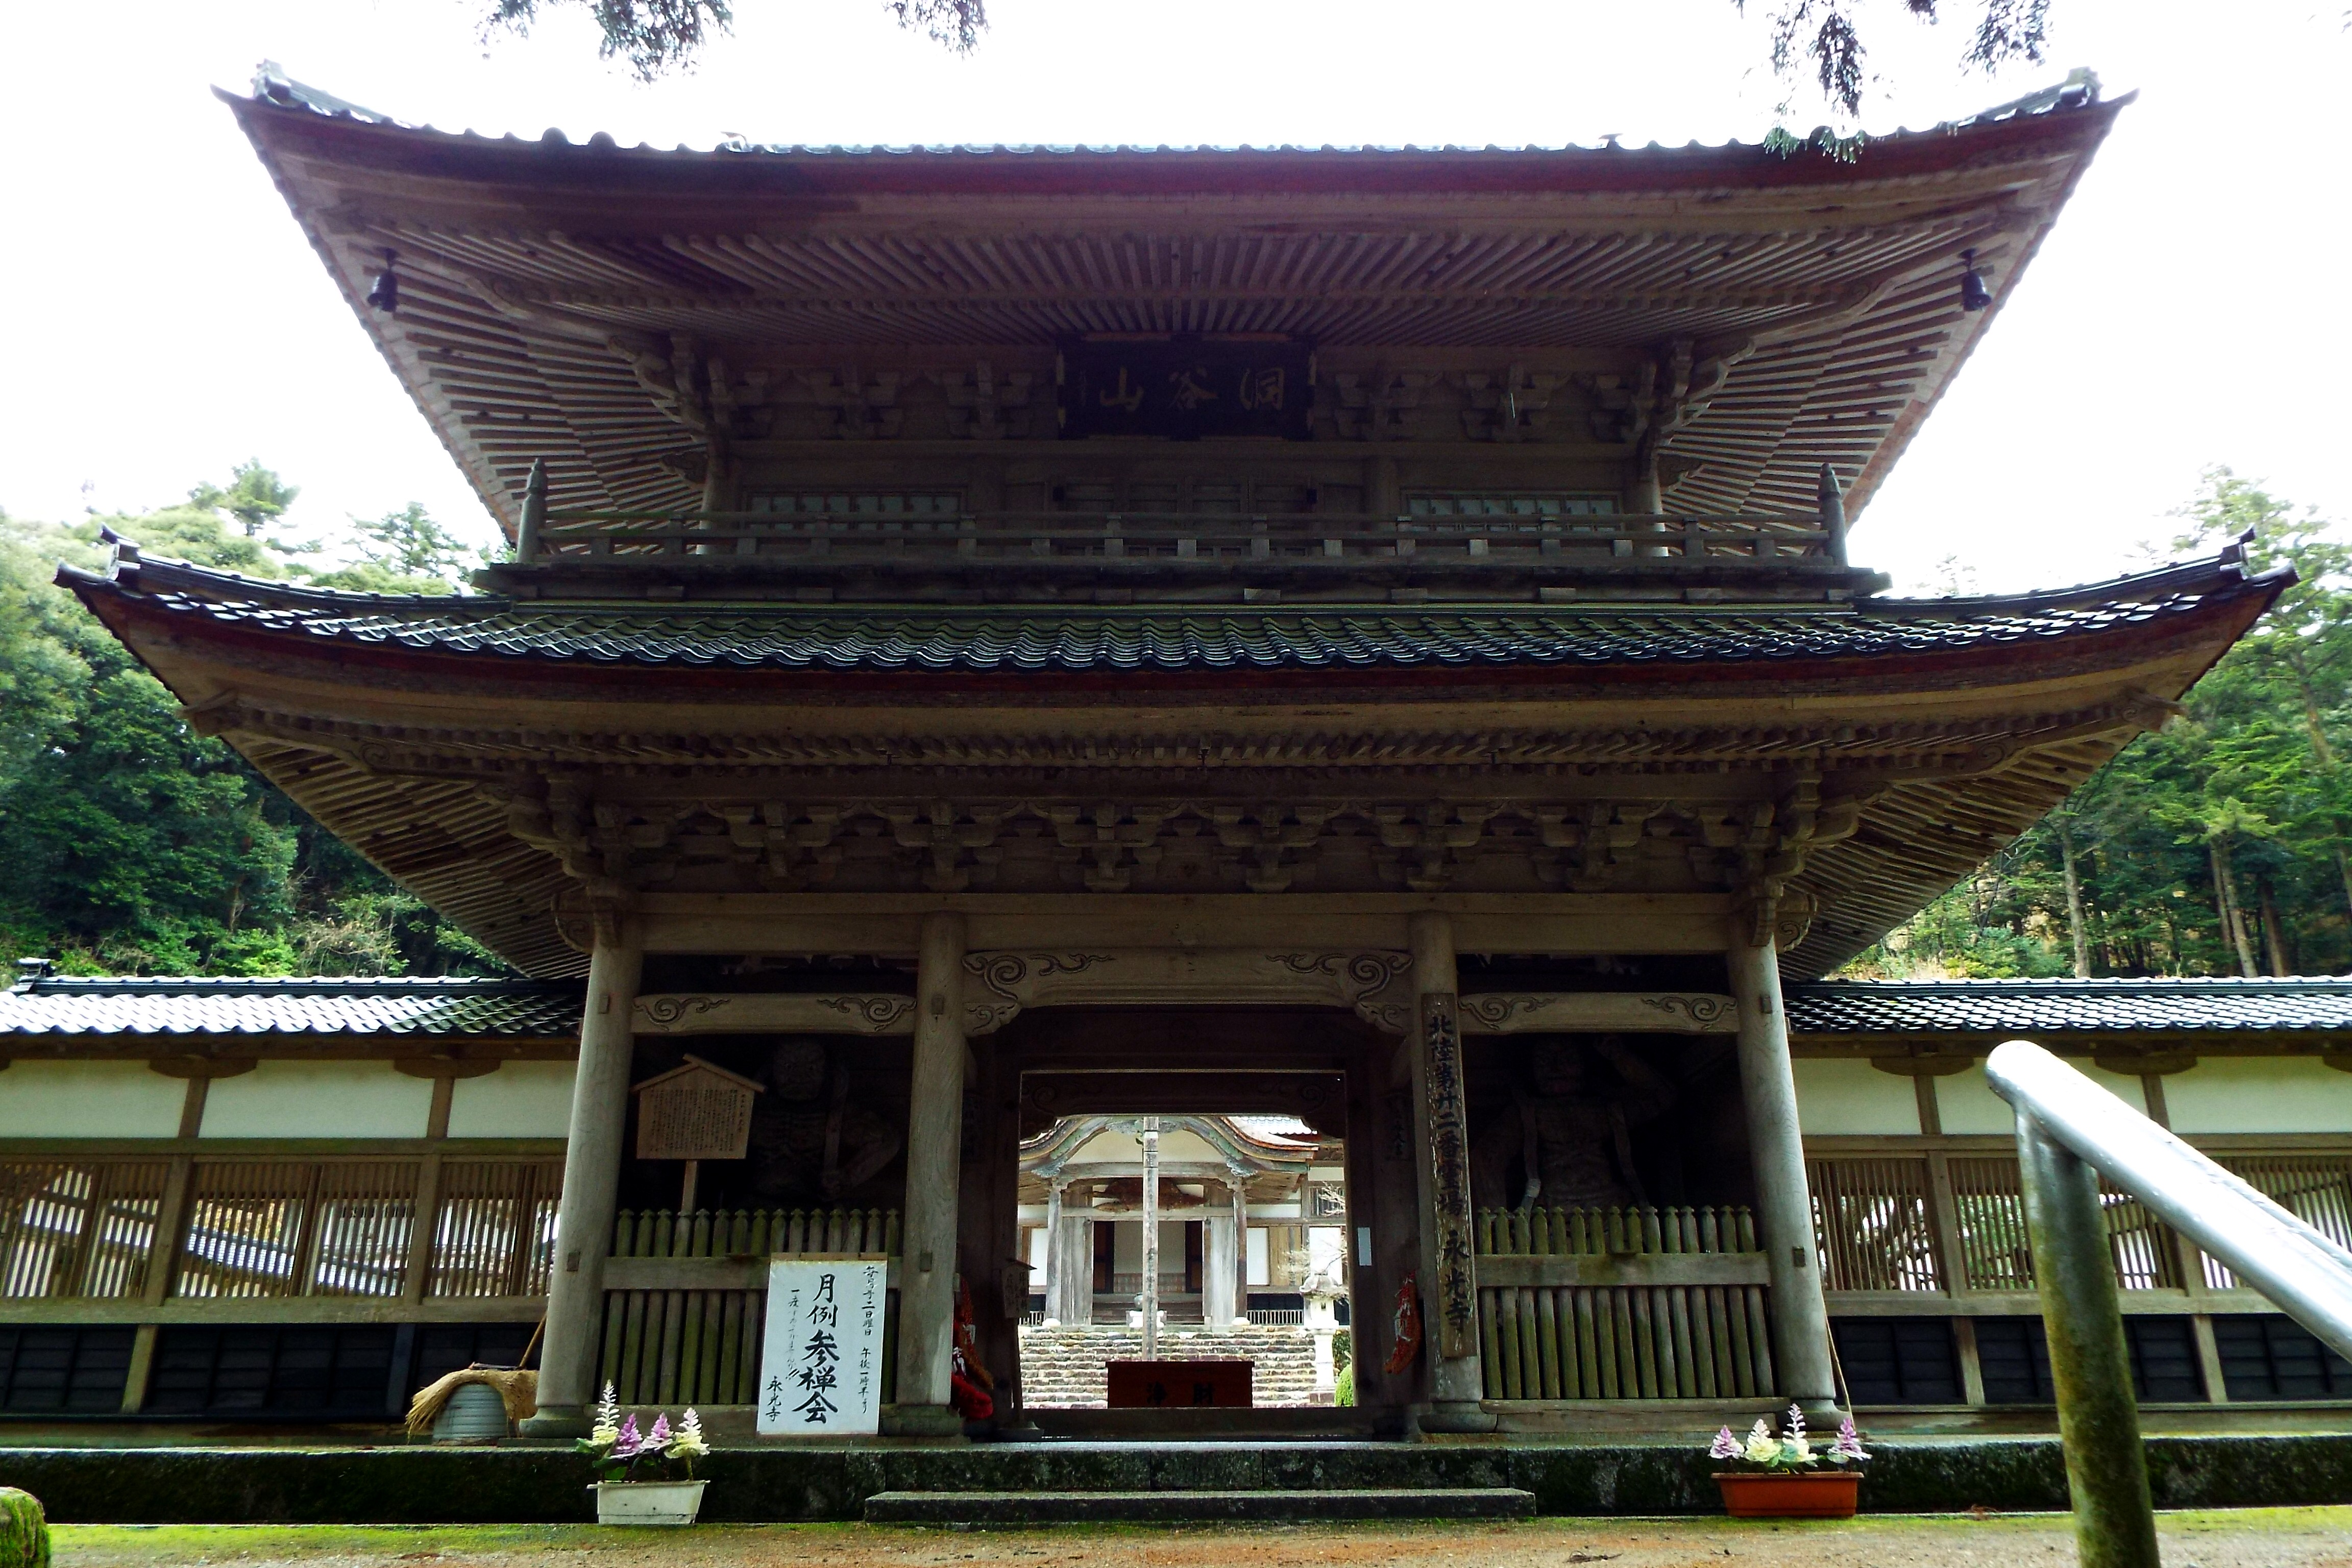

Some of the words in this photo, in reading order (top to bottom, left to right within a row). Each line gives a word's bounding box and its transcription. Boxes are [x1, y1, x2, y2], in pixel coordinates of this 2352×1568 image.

[1443, 1229, 1471, 1333] 永光寺
[766, 1376, 783, 1423] 永光寺
[792, 1273, 841, 1424] 月例参禅会
